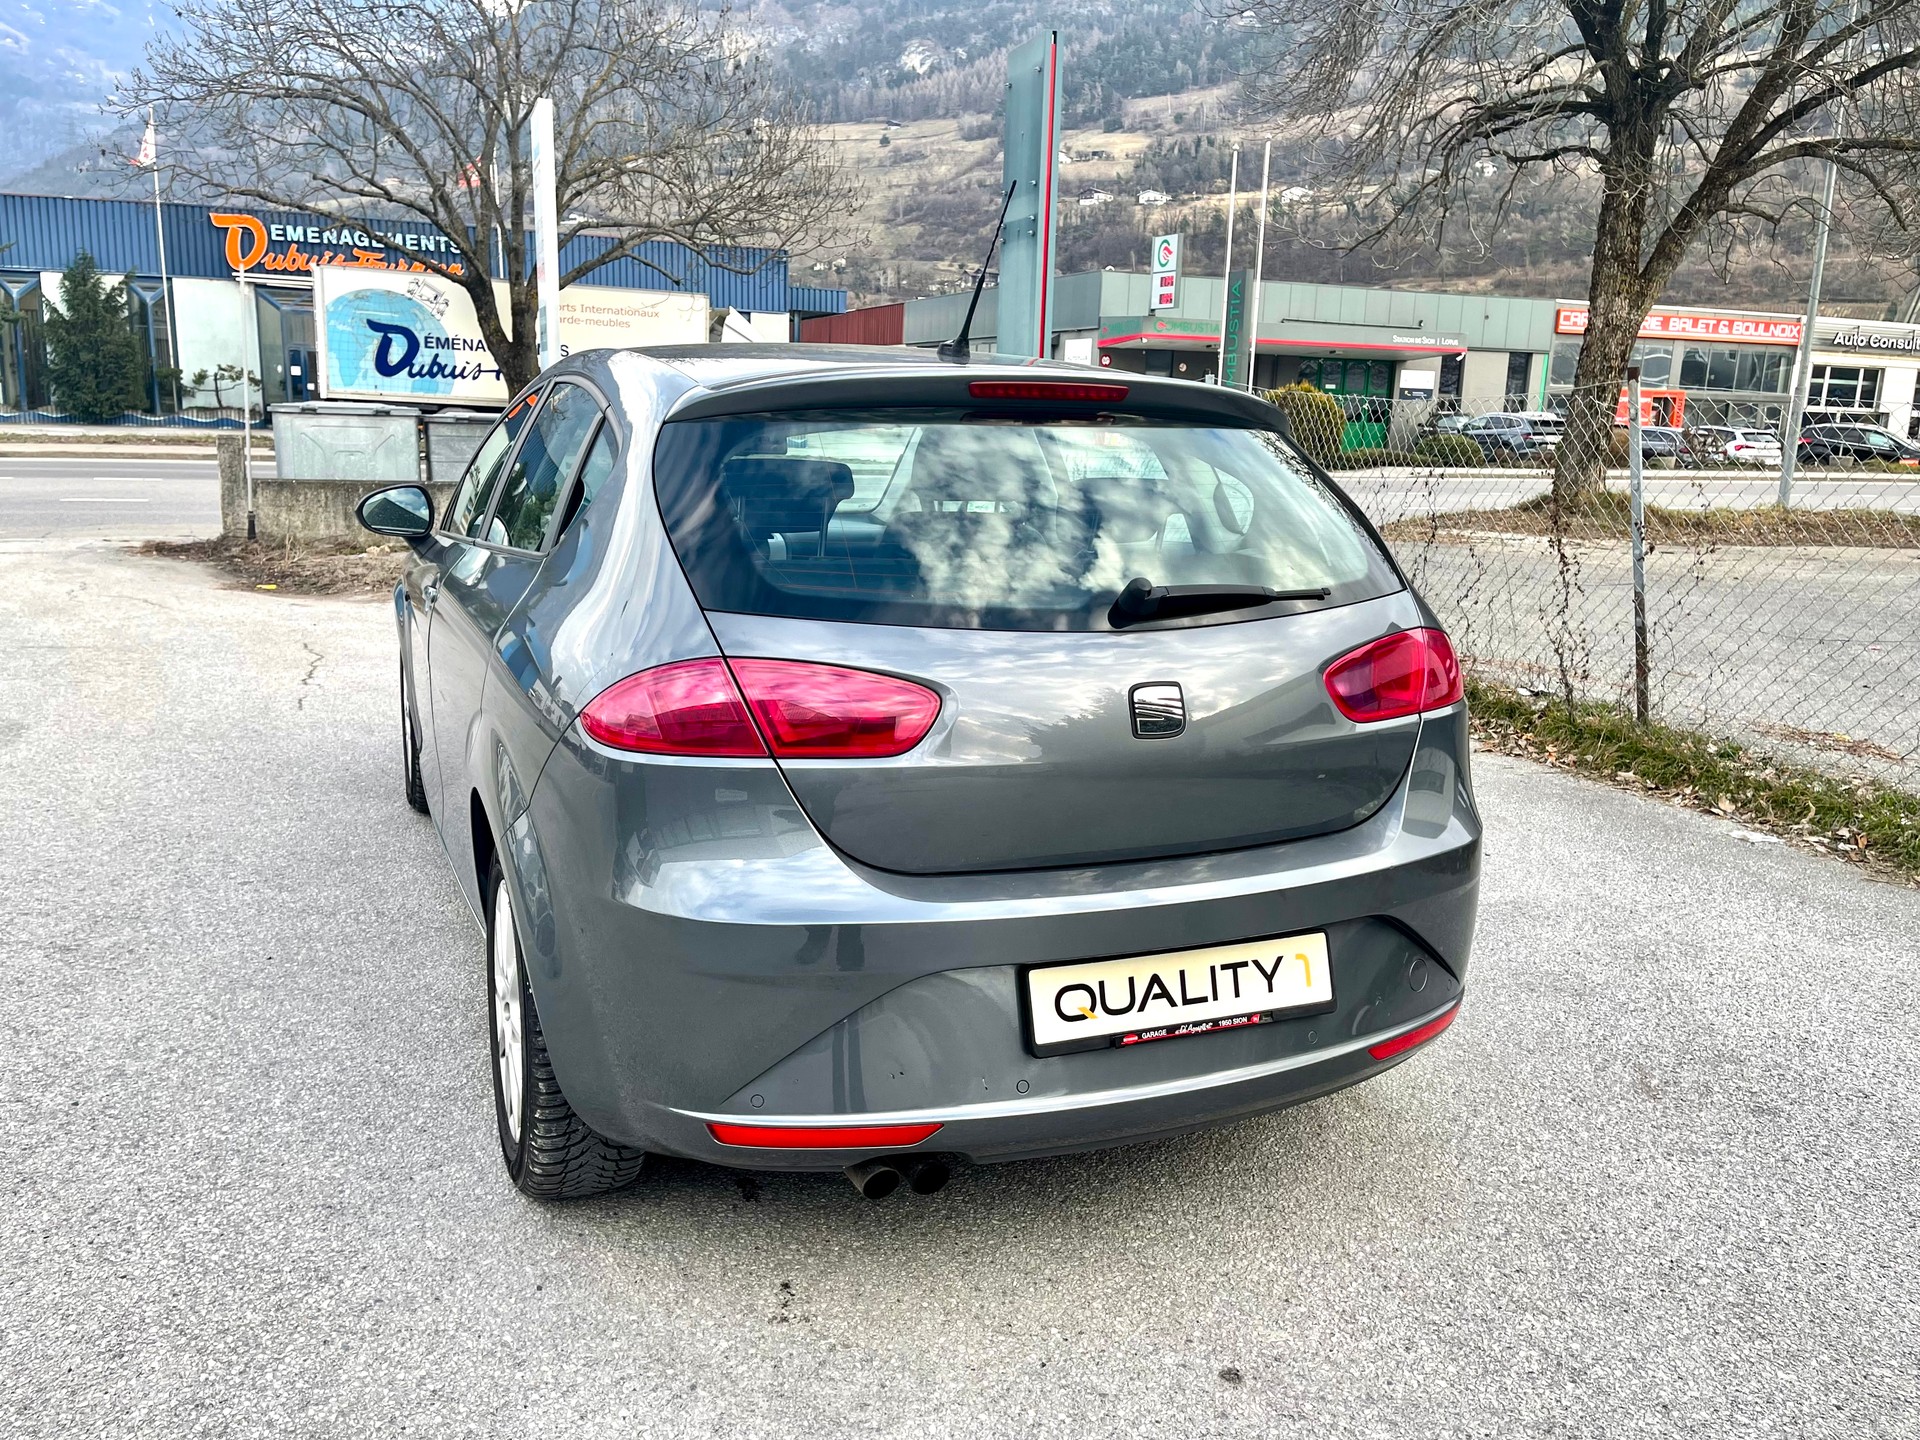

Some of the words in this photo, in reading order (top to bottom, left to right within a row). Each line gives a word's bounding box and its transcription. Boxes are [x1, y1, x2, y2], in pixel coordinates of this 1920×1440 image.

[580, 304, 660, 319] Internationaux
[1668, 317, 1717, 333] BALET
[1718, 320, 1730, 334] &
[1732, 321, 1801, 338] BOULNOIX
[1833, 331, 1867, 347] Auto
[1054, 955, 1285, 1023] QUALITY
[1141, 1028, 1168, 1039] GARAGE
[1218, 1018, 1233, 1027] 1950
[1232, 1016, 1248, 1025] SION
